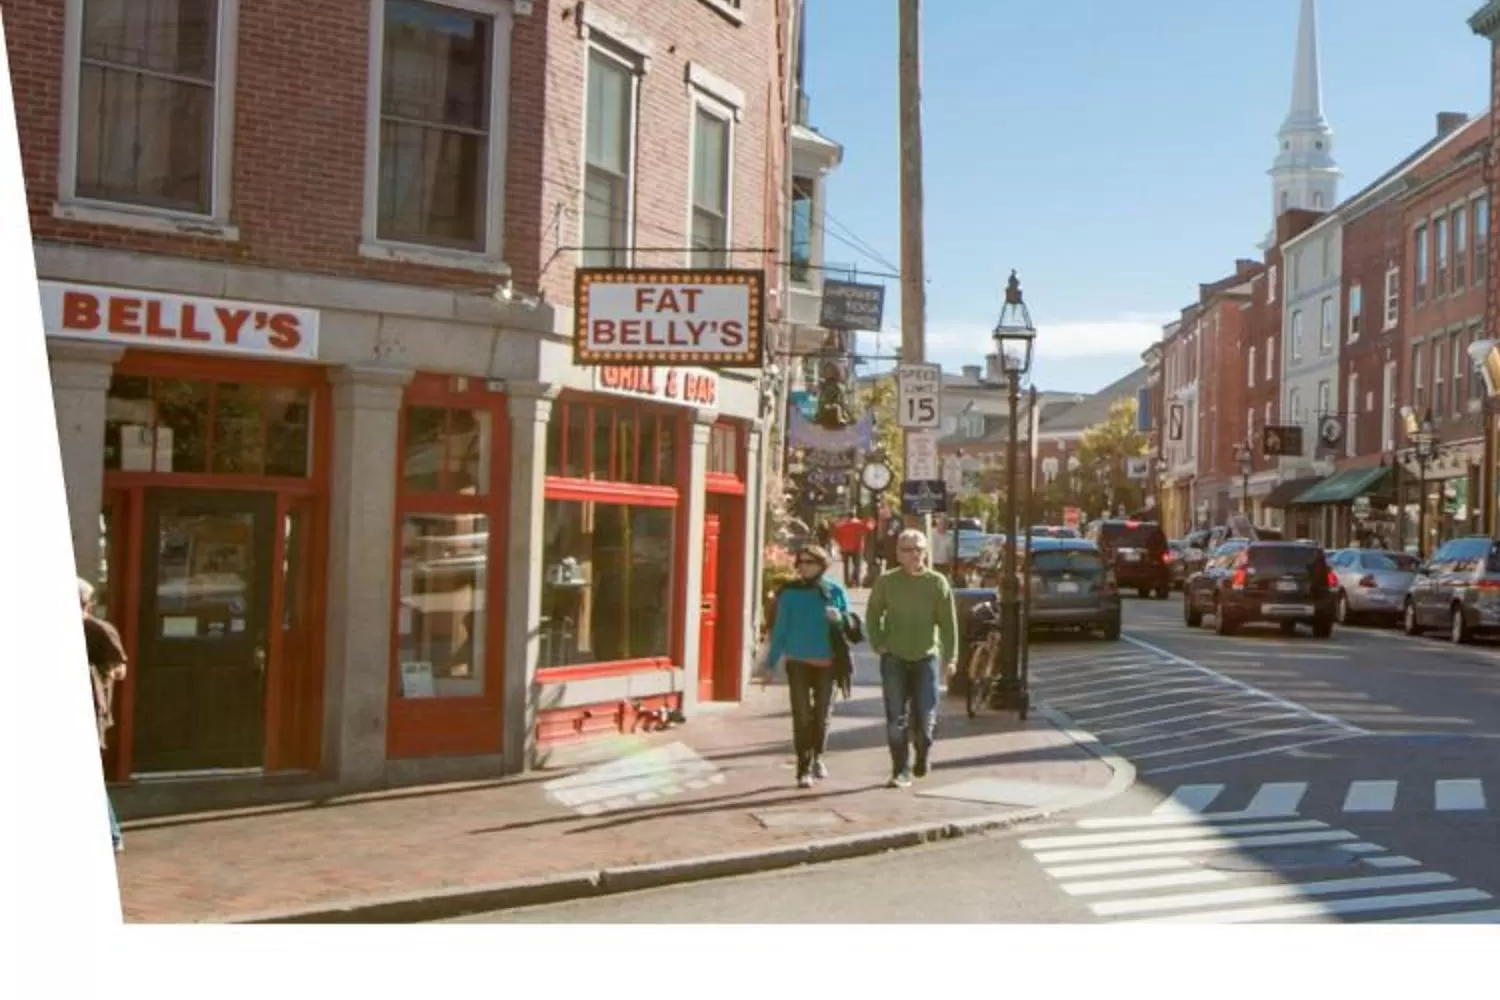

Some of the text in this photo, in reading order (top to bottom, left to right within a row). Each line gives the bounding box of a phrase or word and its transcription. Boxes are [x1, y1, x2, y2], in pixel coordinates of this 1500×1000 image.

[635, 287, 704, 314] FAT
[62, 291, 301, 351] BELLY'S
[592, 319, 744, 347] BELLY'S
[684, 372, 716, 405] BAR
[900, 369, 937, 382] SPEED
[904, 383, 934, 394] LIMIT
[908, 397, 935, 423] 15
